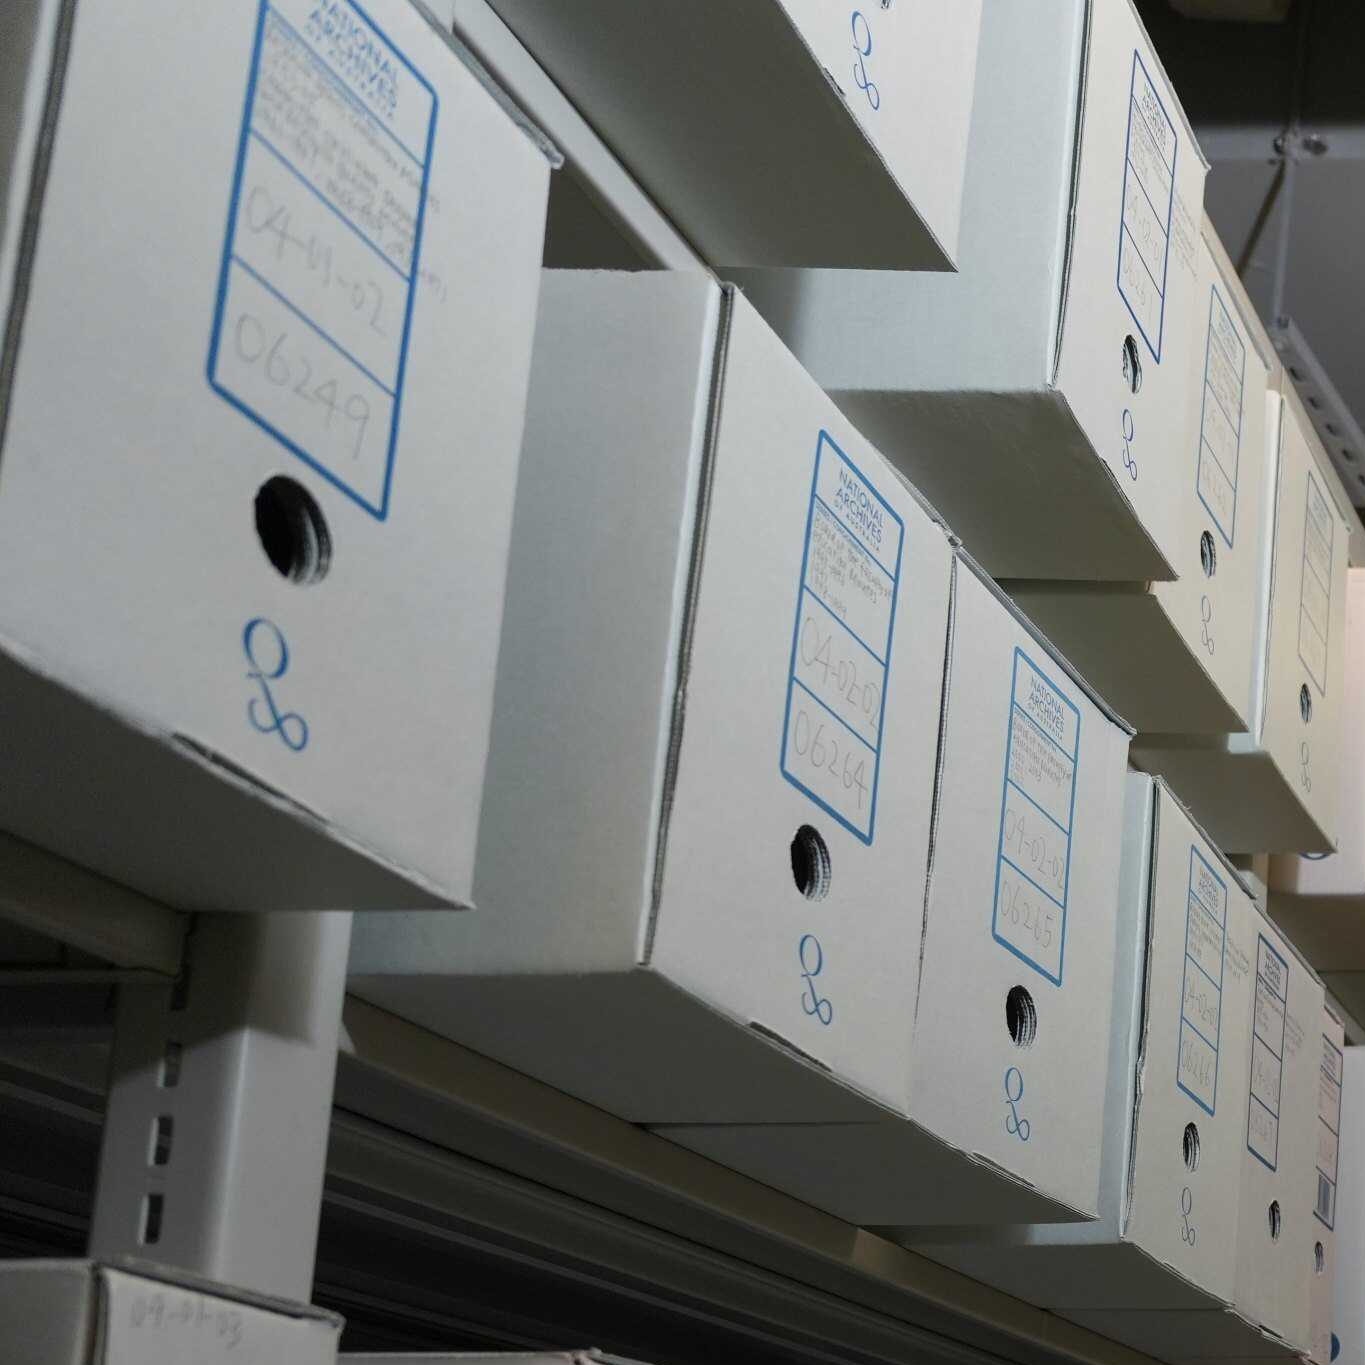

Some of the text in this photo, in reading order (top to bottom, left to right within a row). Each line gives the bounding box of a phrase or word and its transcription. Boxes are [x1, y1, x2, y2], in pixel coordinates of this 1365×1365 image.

[307, 8, 397, 108] ARCHIVES
[233, 312, 371, 462] 06249
[835, 487, 883, 544] ARCHIVES
[839, 468, 883, 529] NATIONAL
[801, 616, 881, 729] 04-02-02
[1030, 674, 1065, 721] NATIONAL
[1028, 690, 1065, 733] ARCHIVES
[794, 709, 869, 811] 06264
[1000, 879, 1054, 949] 06265
